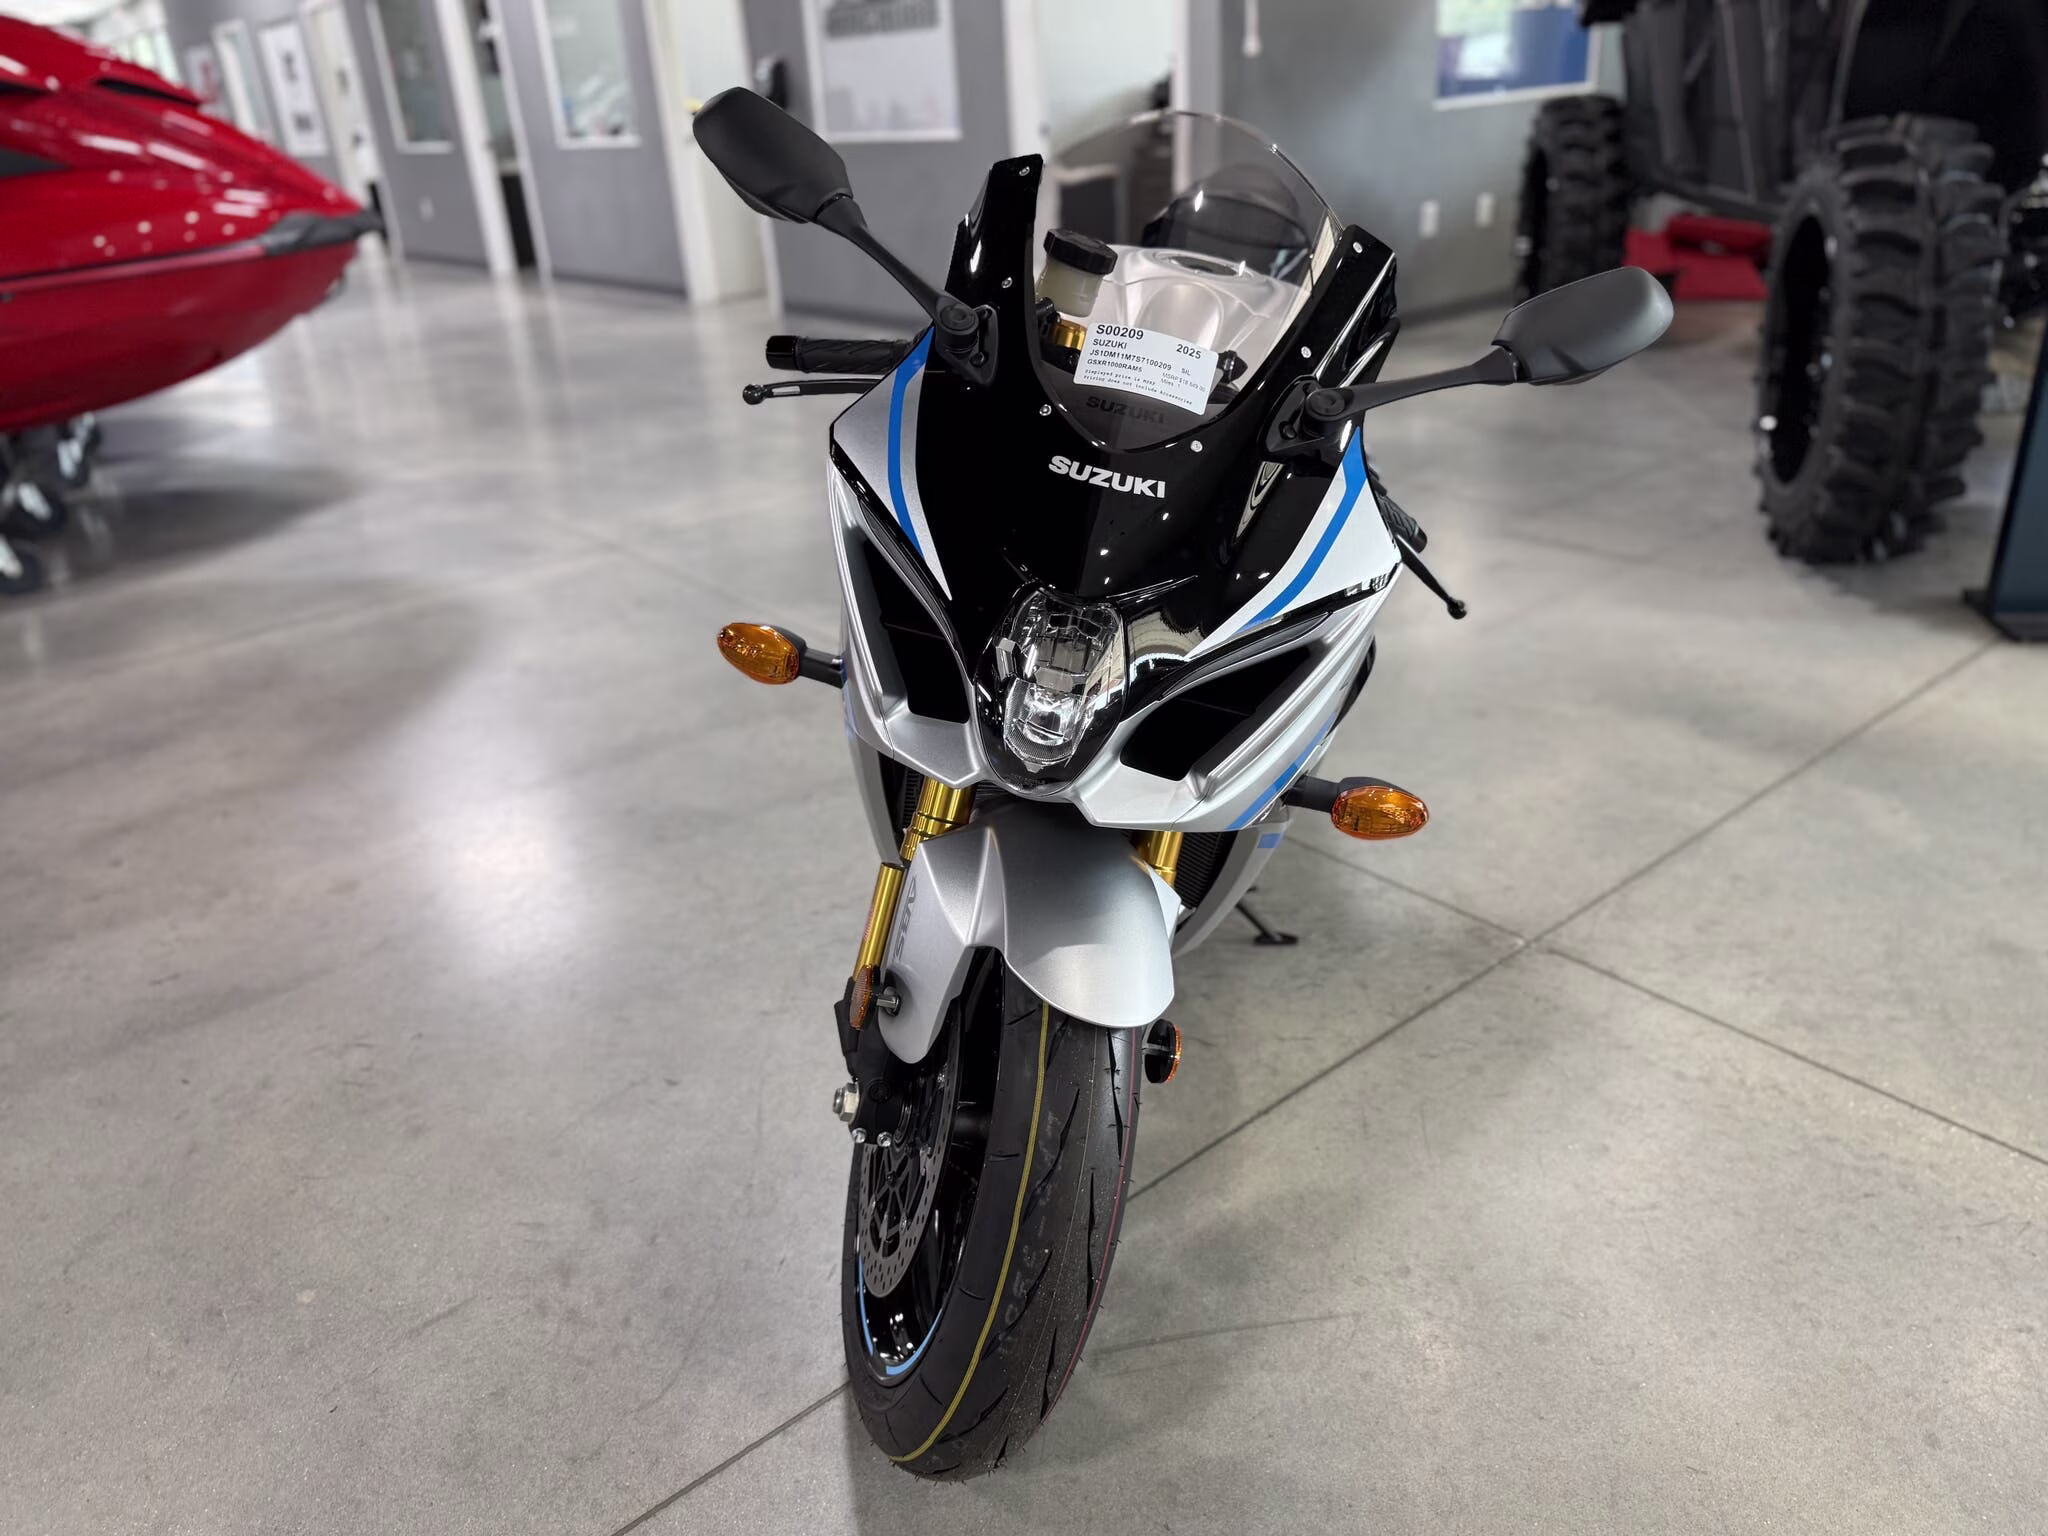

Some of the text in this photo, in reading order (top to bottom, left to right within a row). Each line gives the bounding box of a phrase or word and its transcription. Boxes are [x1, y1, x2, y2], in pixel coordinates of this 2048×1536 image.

[1096, 324, 1144, 340] S00209
[1092, 338, 1128, 350] SUZUKI
[1176, 343, 1202, 360] 2025
[1086, 396, 1165, 424] SUZUKI
[1048, 455, 1166, 499] SUZUKI
